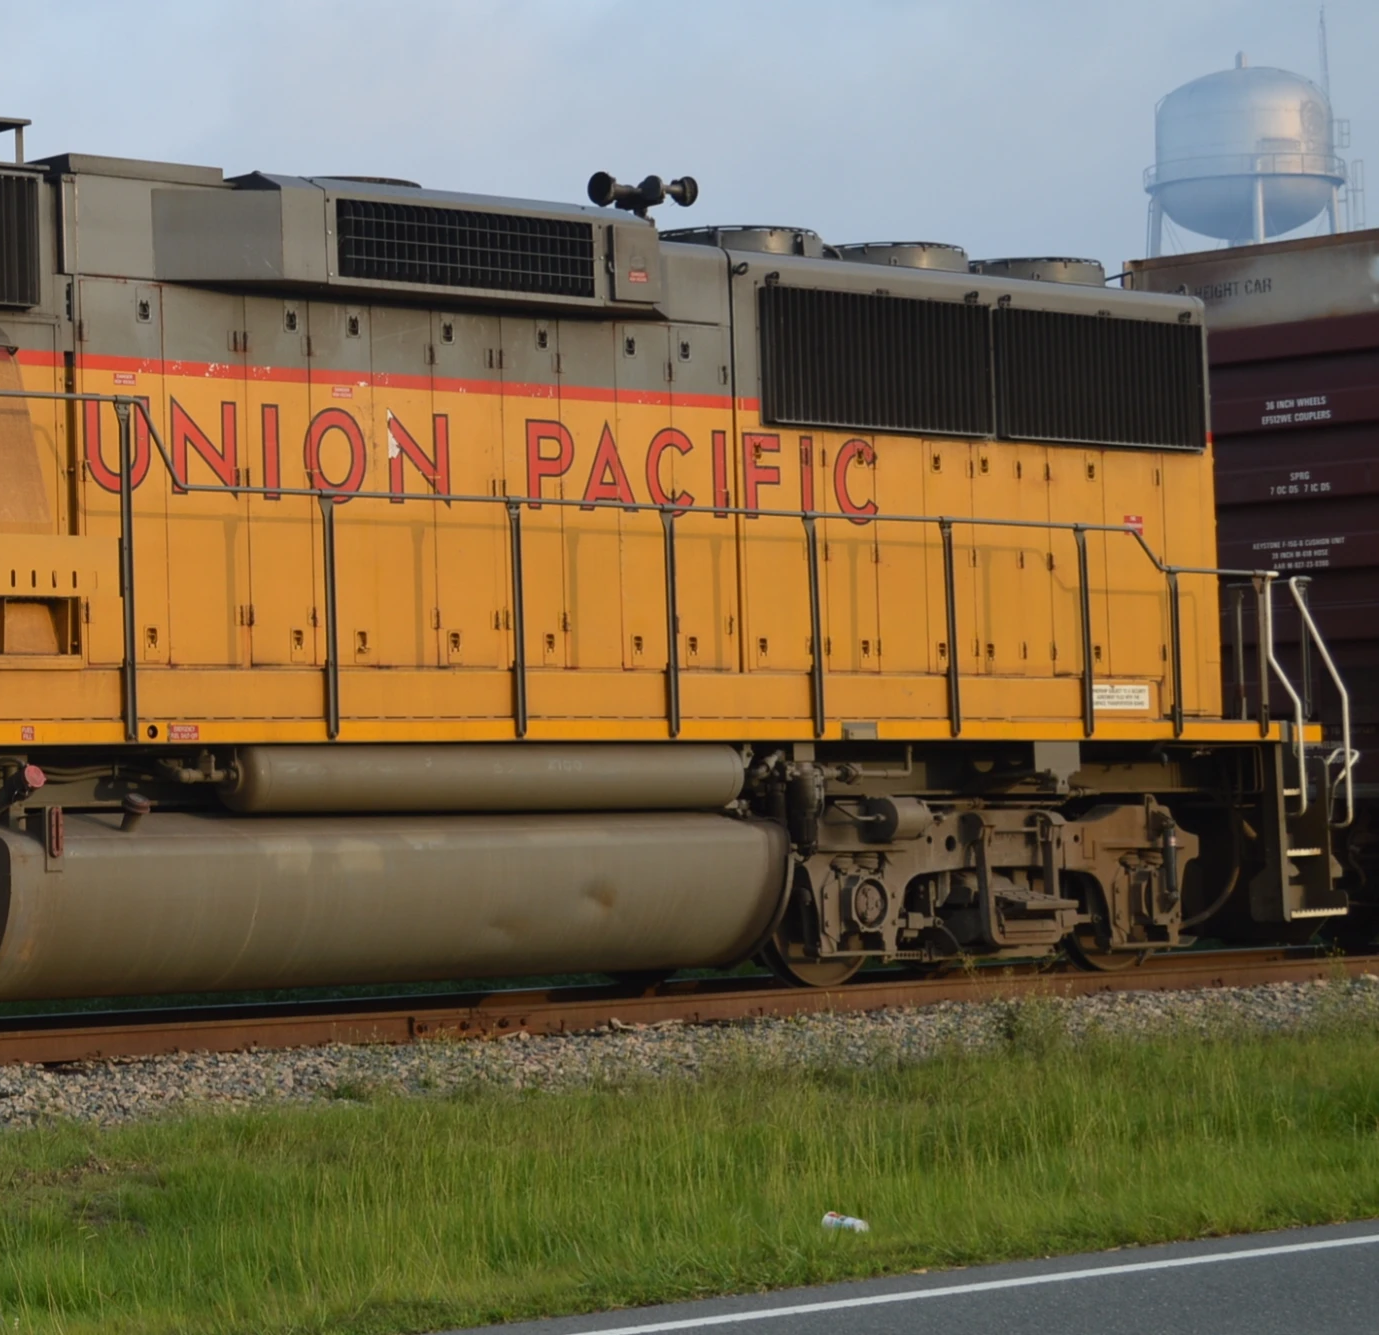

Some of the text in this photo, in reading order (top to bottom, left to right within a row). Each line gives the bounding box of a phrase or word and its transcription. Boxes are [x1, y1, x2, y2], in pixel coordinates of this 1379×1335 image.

[1244, 278, 1273, 295] CAR
[1276, 399, 1294, 409] INCH
[1296, 396, 1326, 407] WHEELS
[1294, 410, 1331, 422] COUPLERS
[82, 393, 879, 526] UNION PACIFIC
